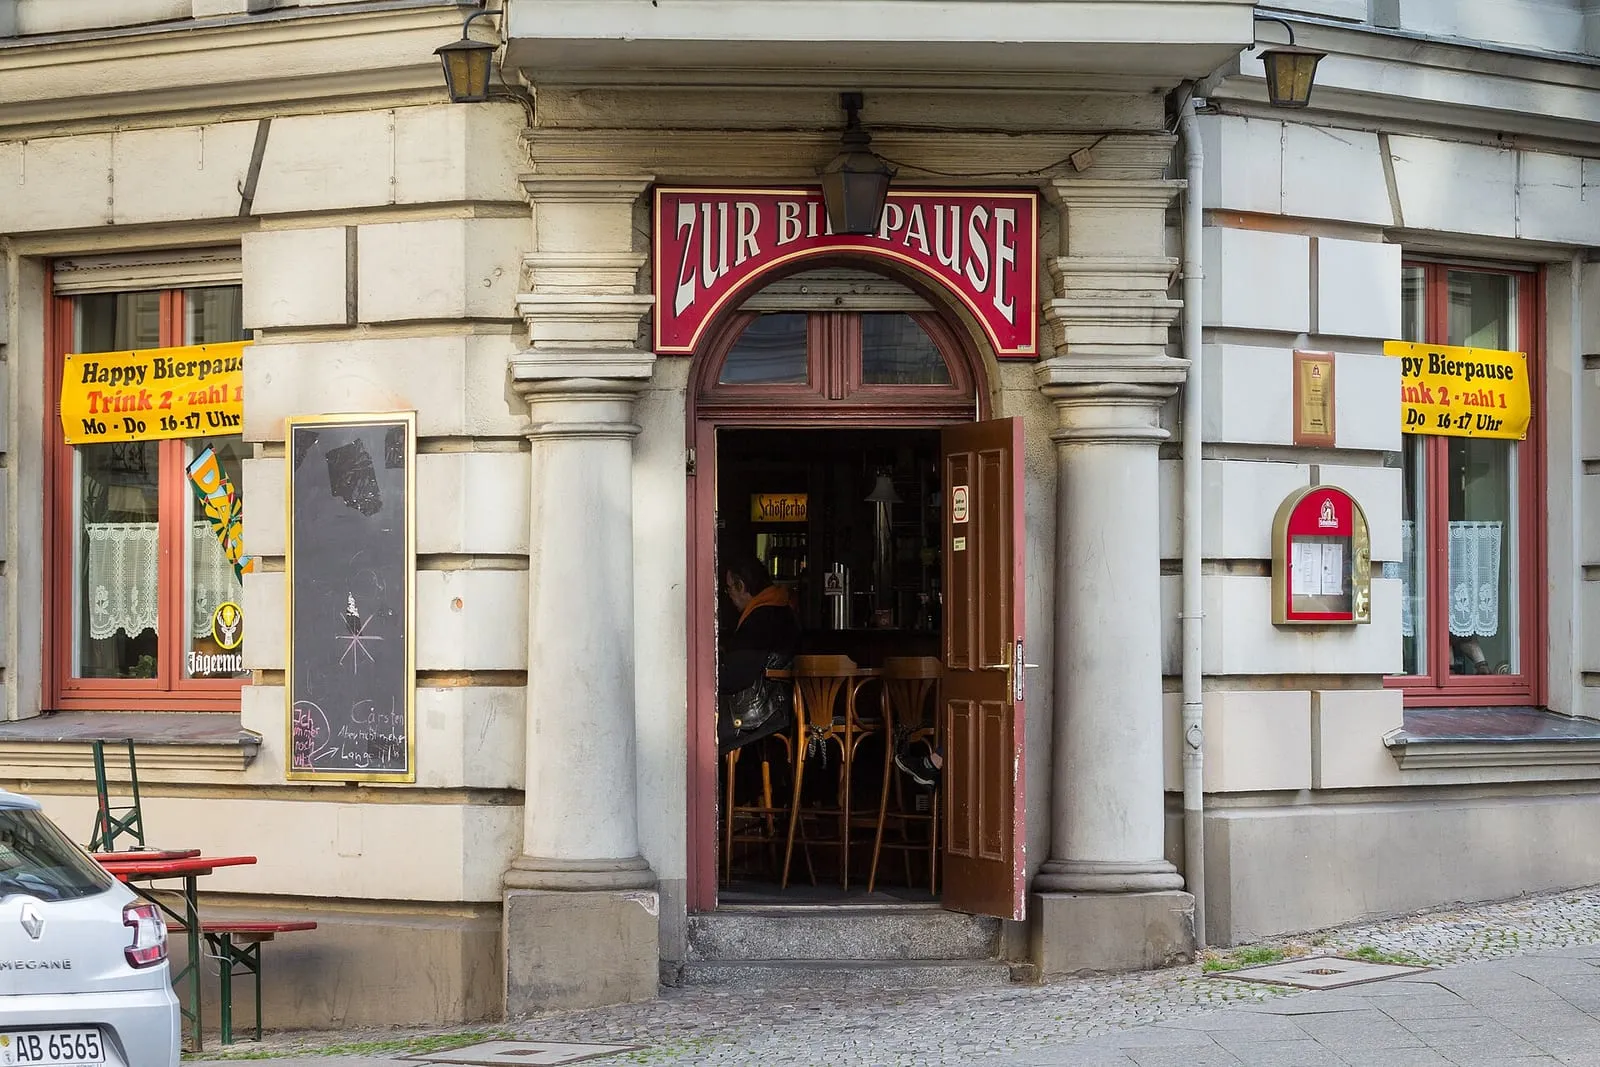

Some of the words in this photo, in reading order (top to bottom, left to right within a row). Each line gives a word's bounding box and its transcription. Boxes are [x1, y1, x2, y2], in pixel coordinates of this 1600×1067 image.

[674, 199, 761, 318] ZUR
[777, 201, 1016, 325] BIPAUSE
[81, 362, 148, 387] Happy
[1428, 353, 1514, 382] Bierpause
[87, 389, 153, 414] Trink
[158, 391, 173, 410] 2
[188, 384, 228, 405] zahl
[233, 385, 243, 402] 1
[1438, 386, 1450, 407] 2
[1463, 389, 1495, 408] zahl
[1499, 393, 1507, 409] 1
[81, 418, 107, 435] Mo
[123, 417, 146, 434] Do
[206, 411, 241, 428] Uhr
[1406, 408, 1425, 426] Do
[1476, 413, 1503, 431] Uhr
[187, 651, 250, 675] Jägerme
[0, 959, 72, 971] MEGANE
[17, 1035, 43, 1062] AB
[49, 1034, 99, 1060] 6565
